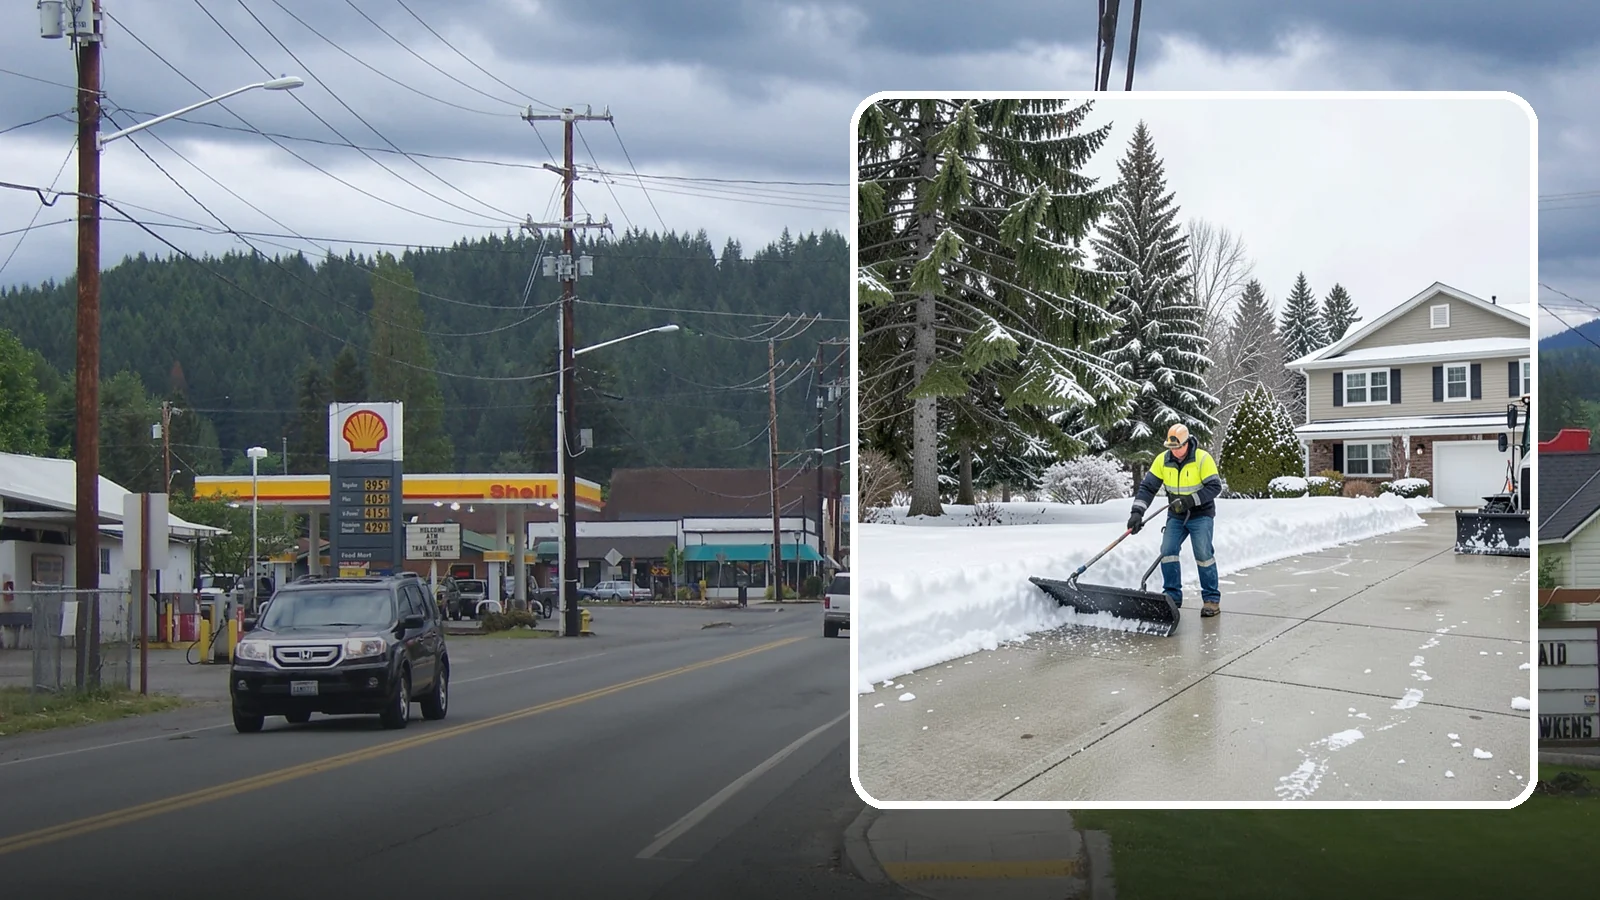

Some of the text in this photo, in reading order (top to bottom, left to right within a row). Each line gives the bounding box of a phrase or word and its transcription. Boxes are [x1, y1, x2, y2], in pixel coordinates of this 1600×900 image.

[365, 480, 383, 490] 395
[490, 484, 547, 499] Shell
[365, 494, 384, 504] 405
[365, 508, 384, 518] 415
[365, 522, 383, 532] 429
